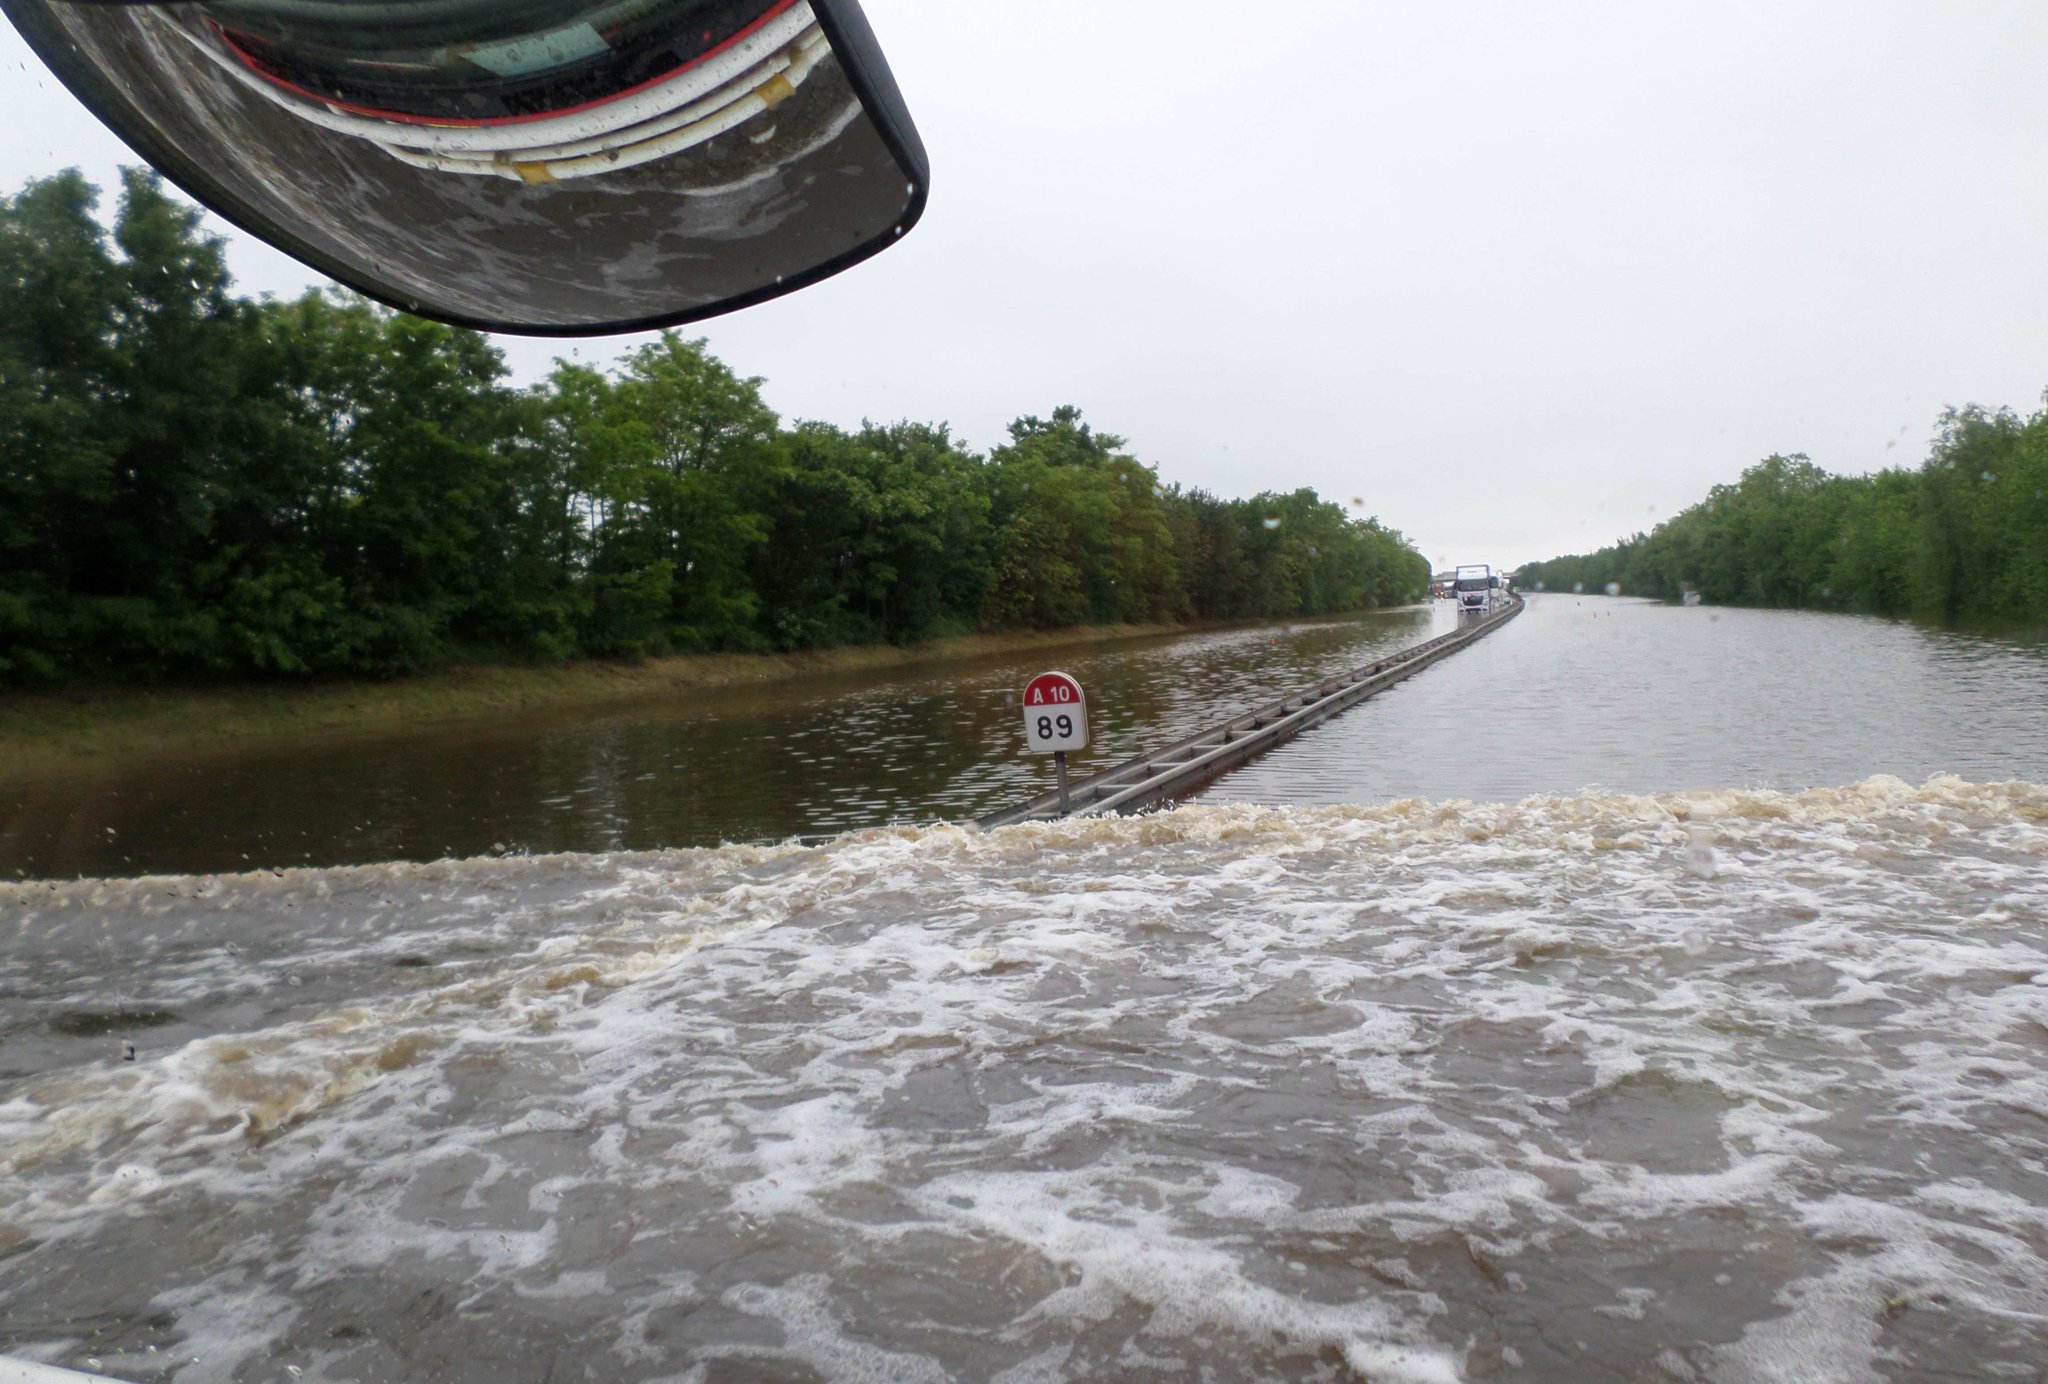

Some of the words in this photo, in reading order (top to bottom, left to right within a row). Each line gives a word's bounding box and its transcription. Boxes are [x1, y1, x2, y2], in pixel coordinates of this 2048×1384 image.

[1033, 688, 1044, 704] A
[1050, 685, 1070, 703] 10
[1037, 714, 1073, 740] 89
